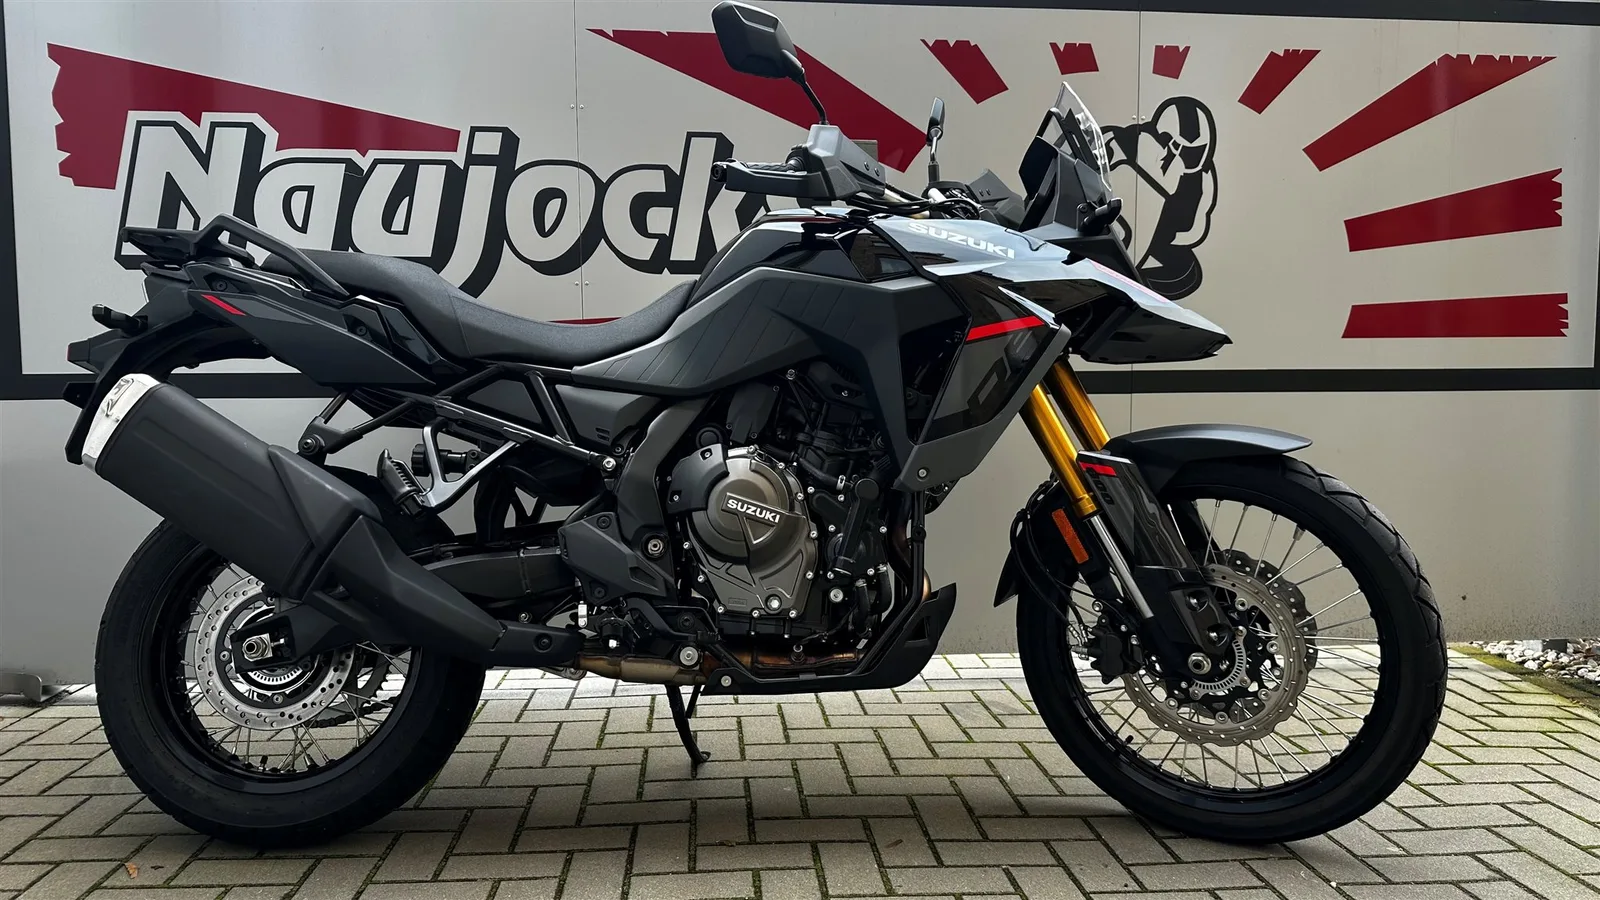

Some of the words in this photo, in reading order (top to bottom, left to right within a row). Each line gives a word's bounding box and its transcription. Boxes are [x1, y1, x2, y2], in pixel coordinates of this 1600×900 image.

[114, 120, 830, 298] Naujock
[908, 222, 1015, 259] SUZUKI
[727, 499, 780, 523] SUZUKI
